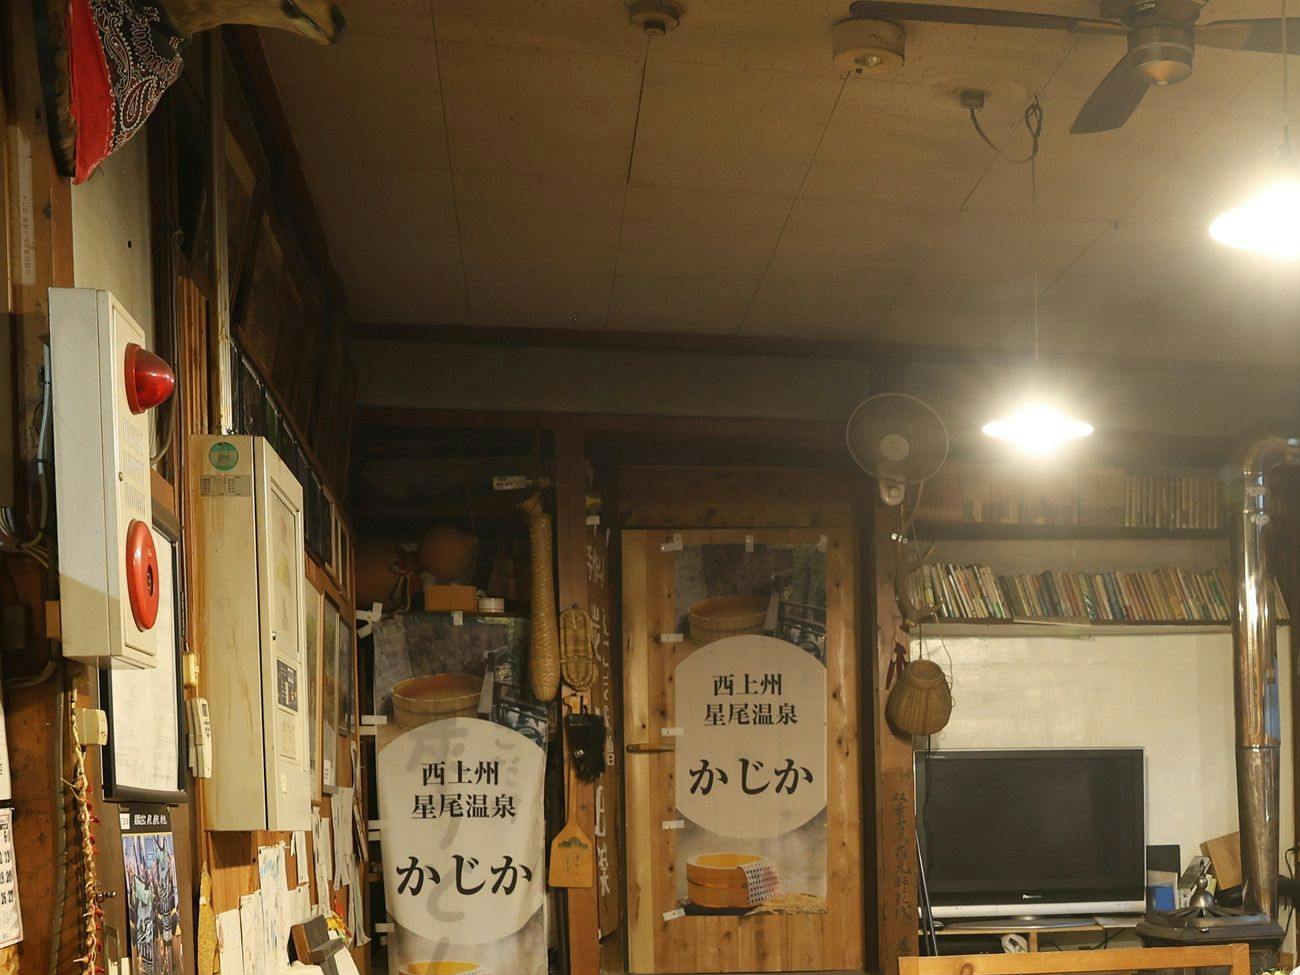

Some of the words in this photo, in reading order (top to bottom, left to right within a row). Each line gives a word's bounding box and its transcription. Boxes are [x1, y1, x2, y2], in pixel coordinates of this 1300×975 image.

[712, 673, 782, 696] 西上州
[704, 703, 798, 726] 星尾温泉
[421, 760, 500, 786] 西上州
[689, 758, 813, 796] かじか
[412, 793, 516, 819] 星尾温泉
[396, 855, 533, 896] かじか
